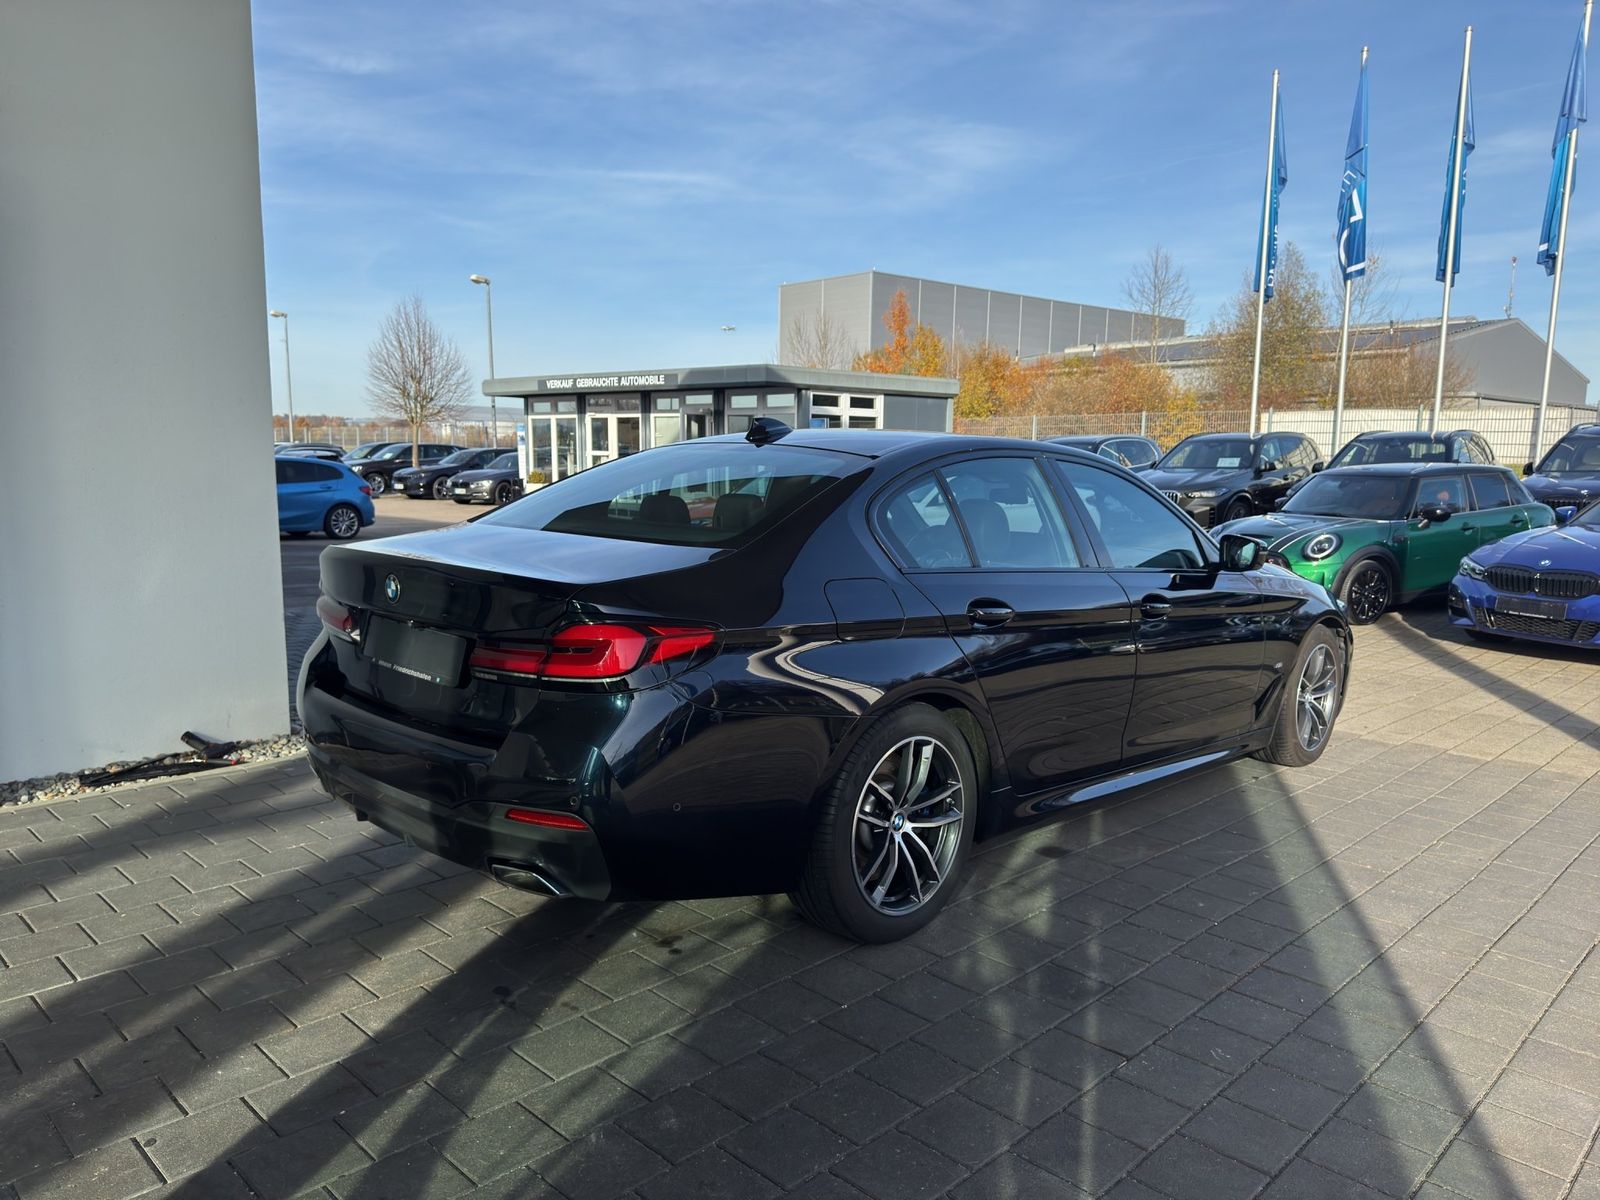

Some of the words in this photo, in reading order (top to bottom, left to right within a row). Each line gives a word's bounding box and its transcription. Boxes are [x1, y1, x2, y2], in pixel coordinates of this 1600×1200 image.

[546, 378, 573, 389] VERKAUF
[576, 376, 619, 388] GEBRAUCHTE
[620, 374, 665, 386] AUTOMOBILE
